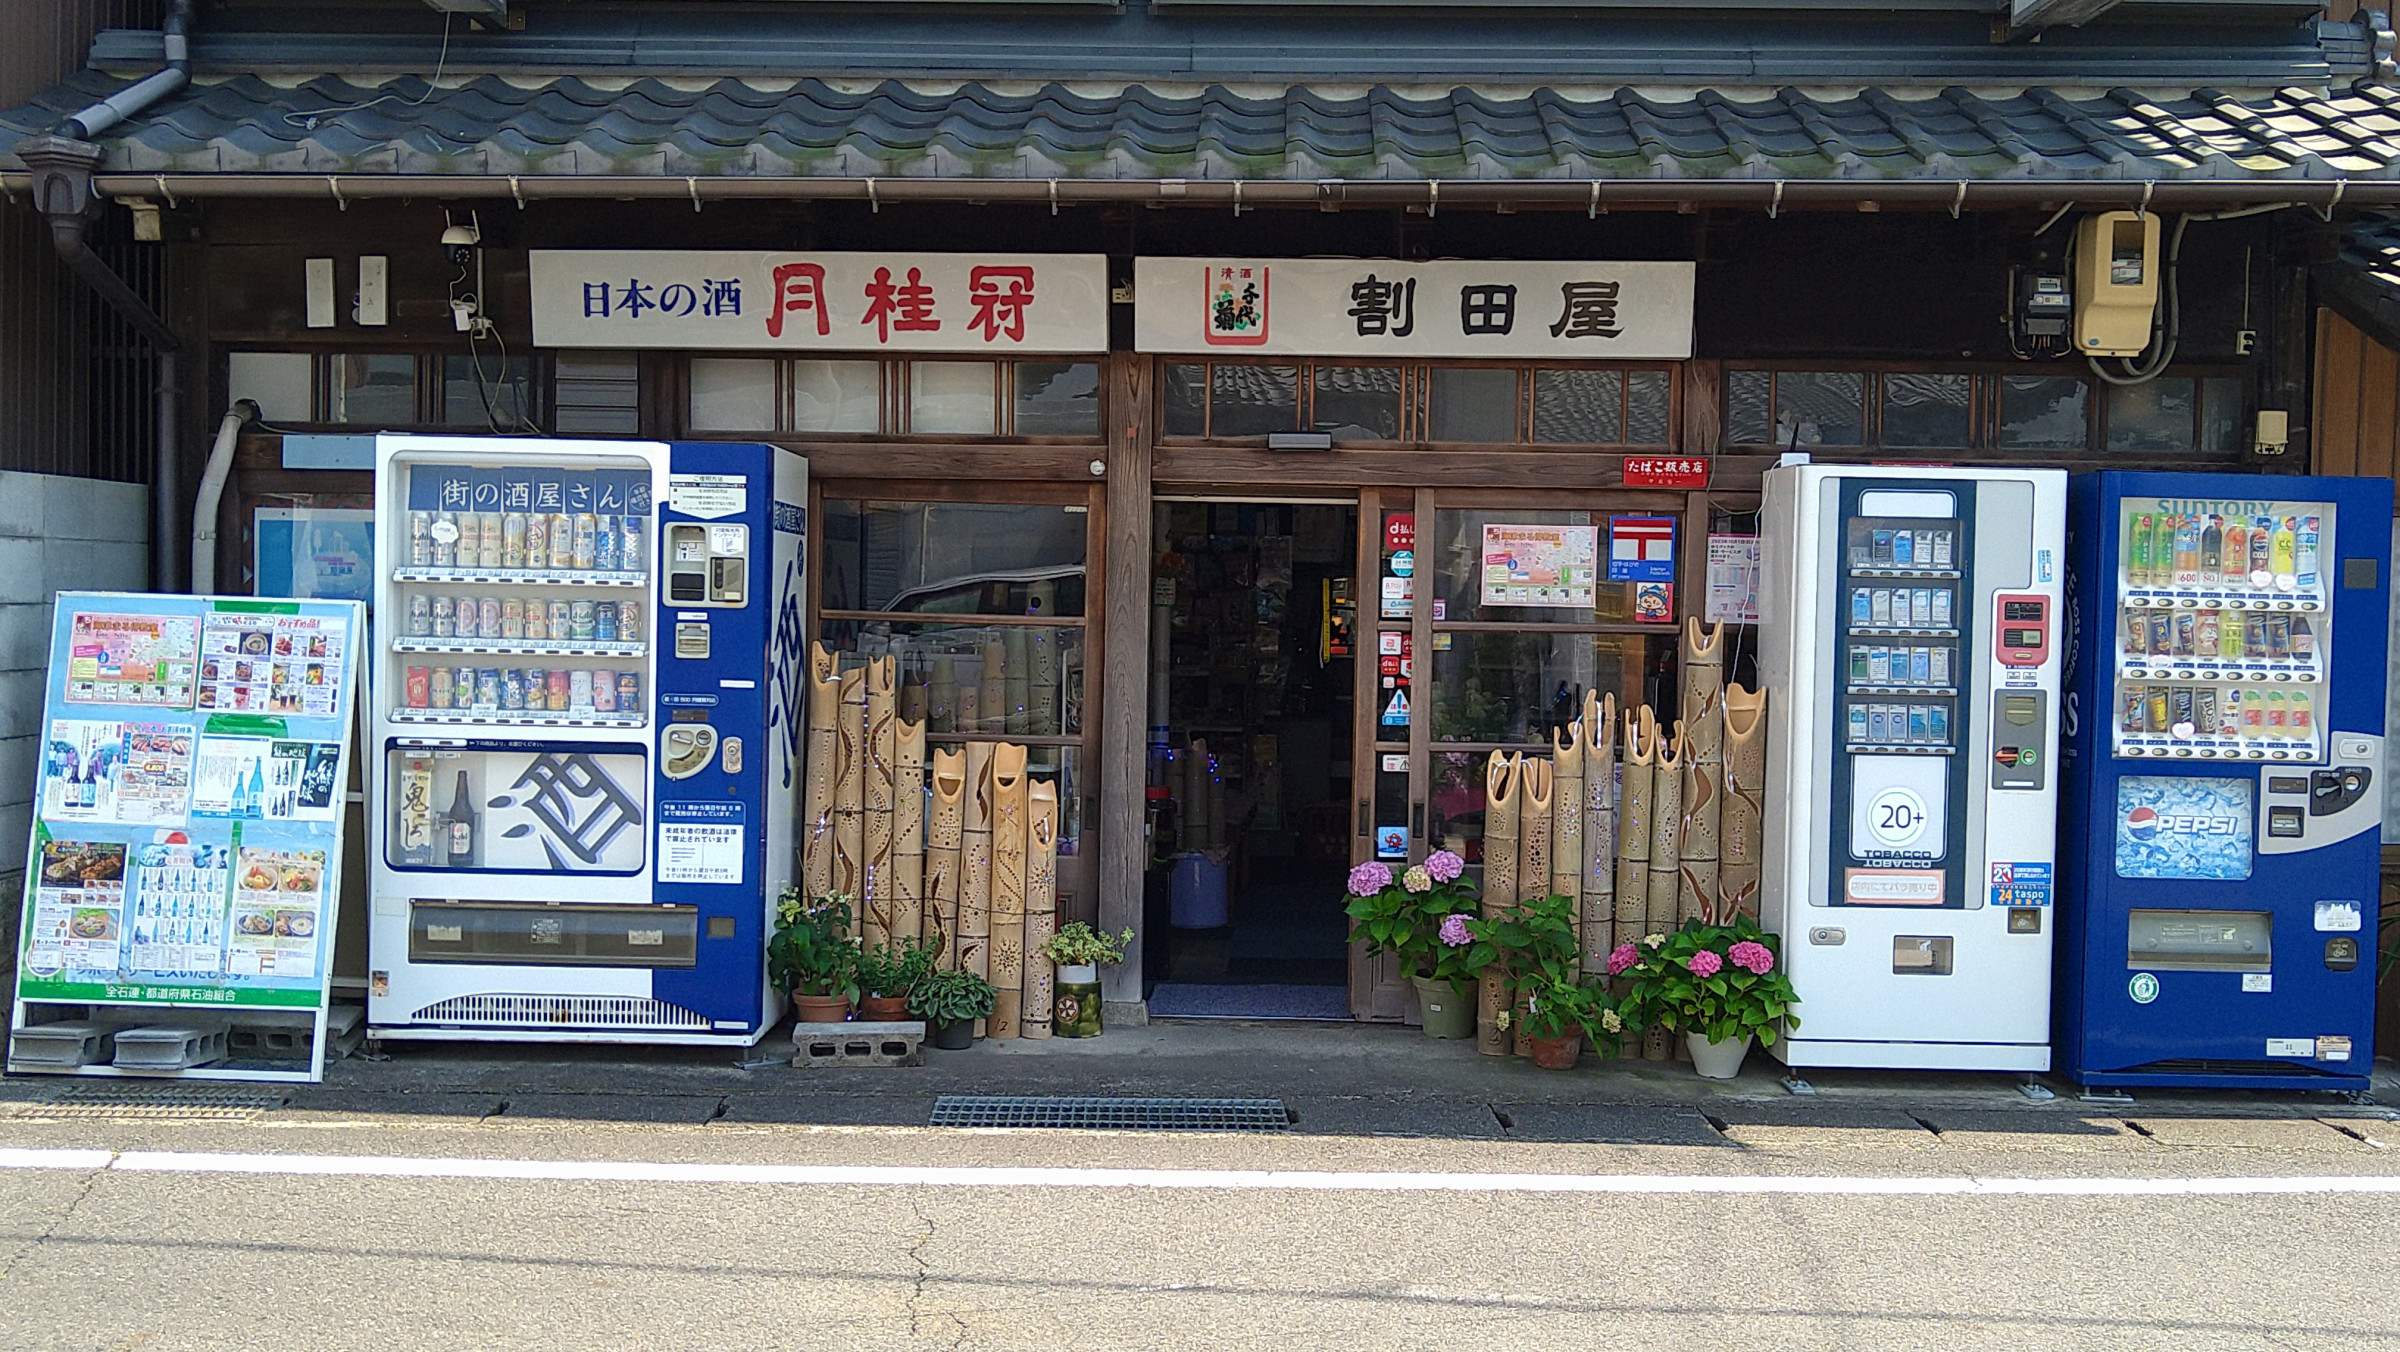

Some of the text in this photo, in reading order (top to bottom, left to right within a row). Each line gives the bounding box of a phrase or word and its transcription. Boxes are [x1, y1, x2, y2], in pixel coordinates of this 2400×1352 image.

[1221, 267, 1253, 280] 清酒
[583, 263, 1035, 342] 日本の酒 月桂冠
[1347, 274, 1626, 339] 割田屋
[1628, 461, 1703, 473] たばこ販売店
[442, 478, 623, 509] 街の酒屋さん
[2157, 500, 2274, 516] SUNTORY
[2203, 700, 2216, 732] BOSS
[665, 827, 737, 836] 未成年者の飲酒は法律
[2156, 815, 2237, 836] PEPSI
[1864, 850, 1931, 859] TOBACCO
[1998, 889, 2013, 902] 24
[2014, 890, 2045, 900] taspo
[105, 987, 236, 1002] 全石連・都道府県石油組合
